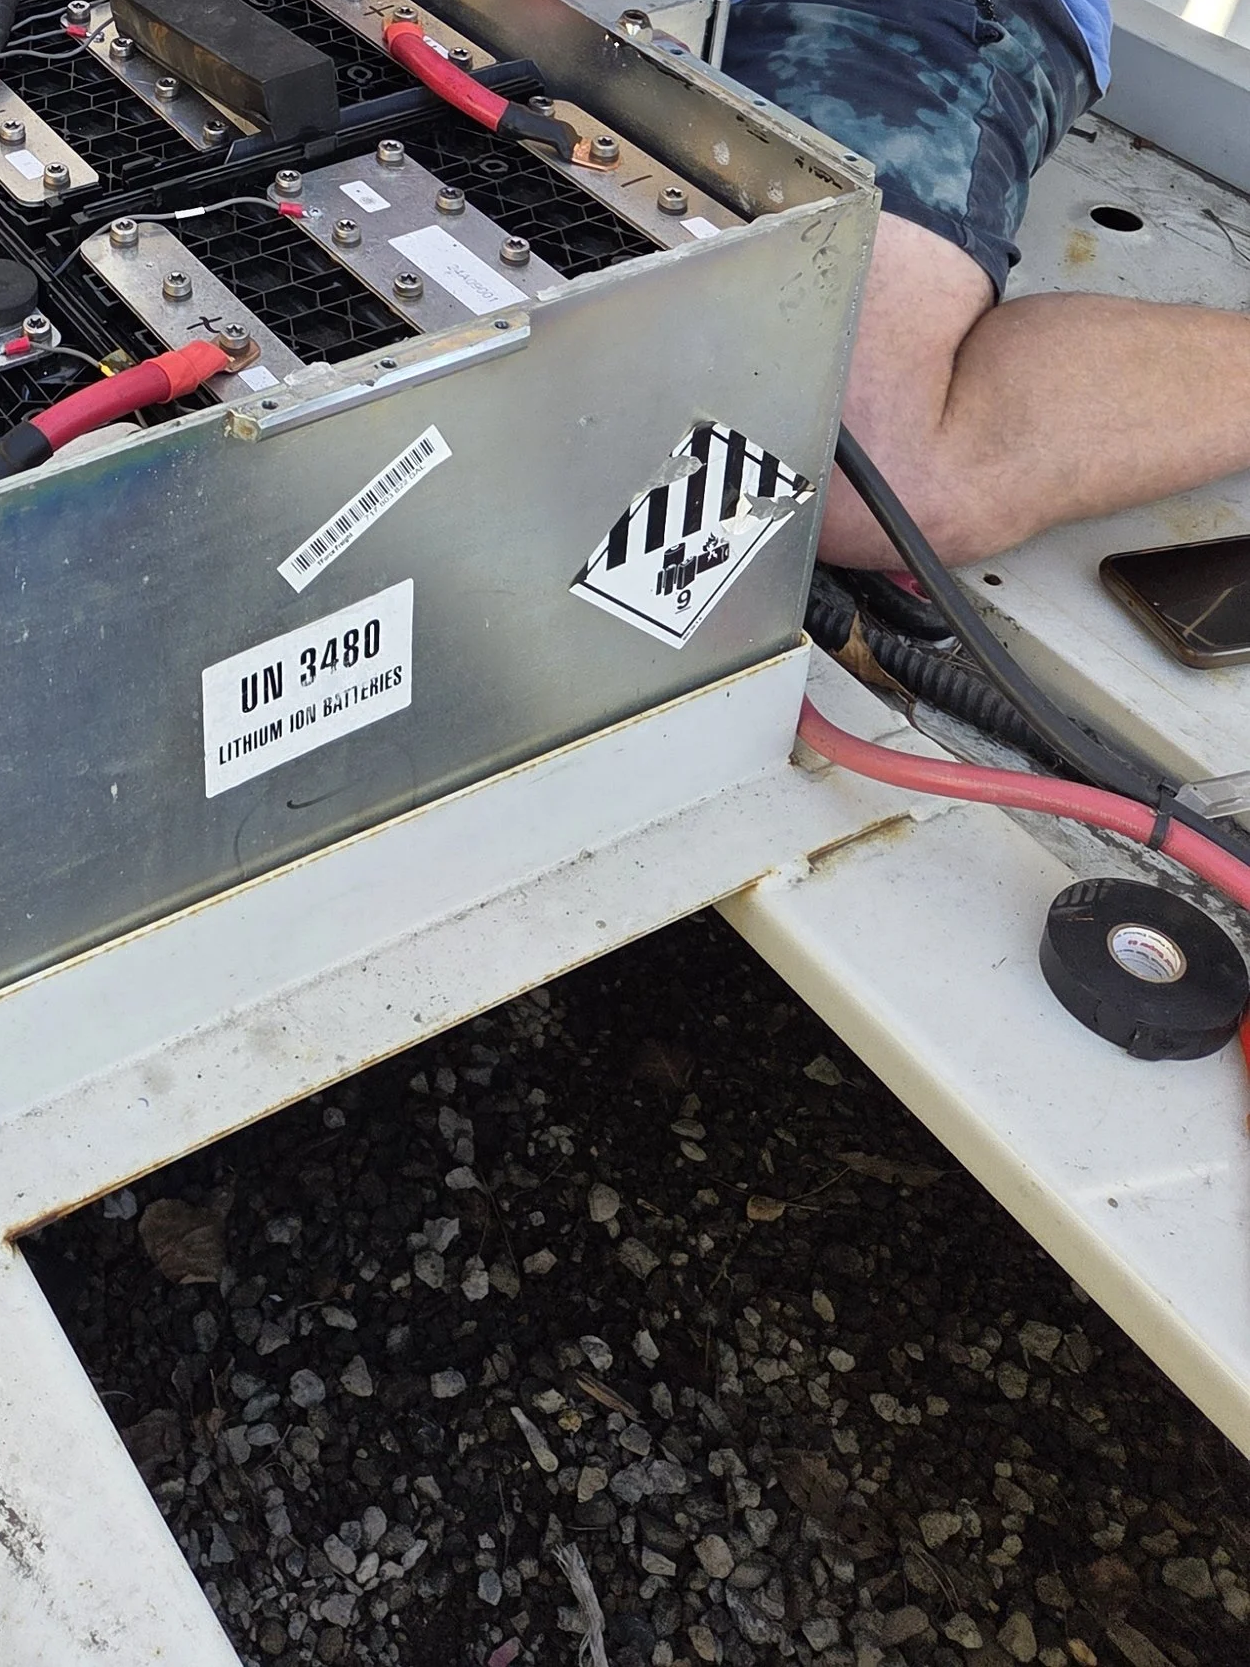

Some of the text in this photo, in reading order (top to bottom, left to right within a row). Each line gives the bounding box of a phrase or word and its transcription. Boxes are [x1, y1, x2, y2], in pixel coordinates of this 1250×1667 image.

[677, 589, 692, 610] 9
[241, 619, 380, 713] UN 3480
[219, 665, 402, 765] LITHIUM ION BATTERIES
